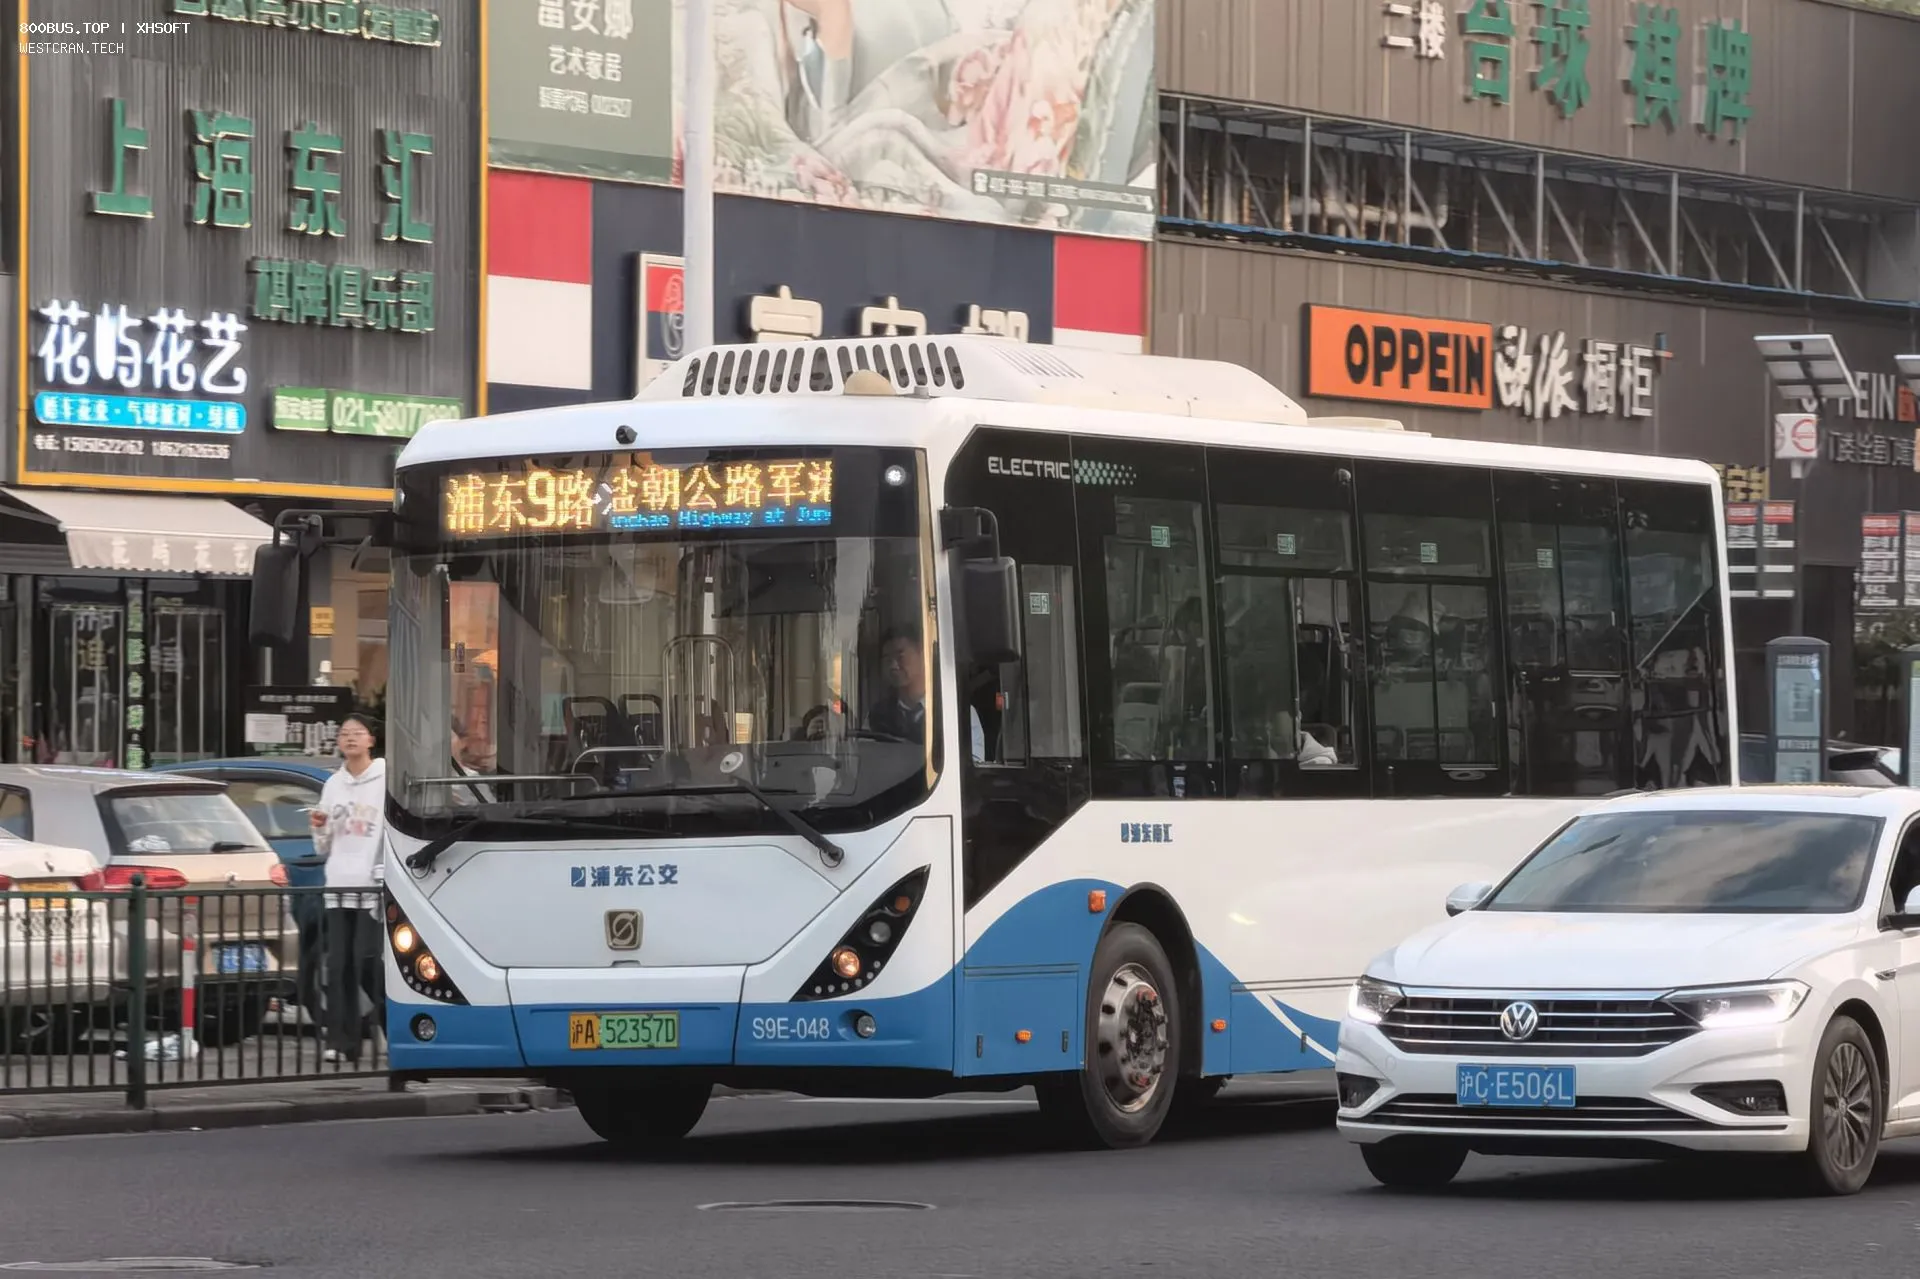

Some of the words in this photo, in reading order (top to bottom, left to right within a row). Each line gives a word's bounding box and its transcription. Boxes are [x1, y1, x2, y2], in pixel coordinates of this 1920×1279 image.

[1386, 2, 1446, 60] 二楼
[548, 45, 622, 82] 艺术家居
[93, 97, 434, 244] 上海东汇
[250, 256, 436, 333] 棋牌俱乐部
[1346, 323, 1486, 396] OPPEIN
[988, 456, 1071, 480] ELECTRIC
[446, 469, 594, 532] 浦东9路
[678, 510, 754, 528] Highway
[764, 508, 785, 523] at
[591, 864, 679, 887] 浦东公交
[752, 1017, 831, 1040] S9E-048
